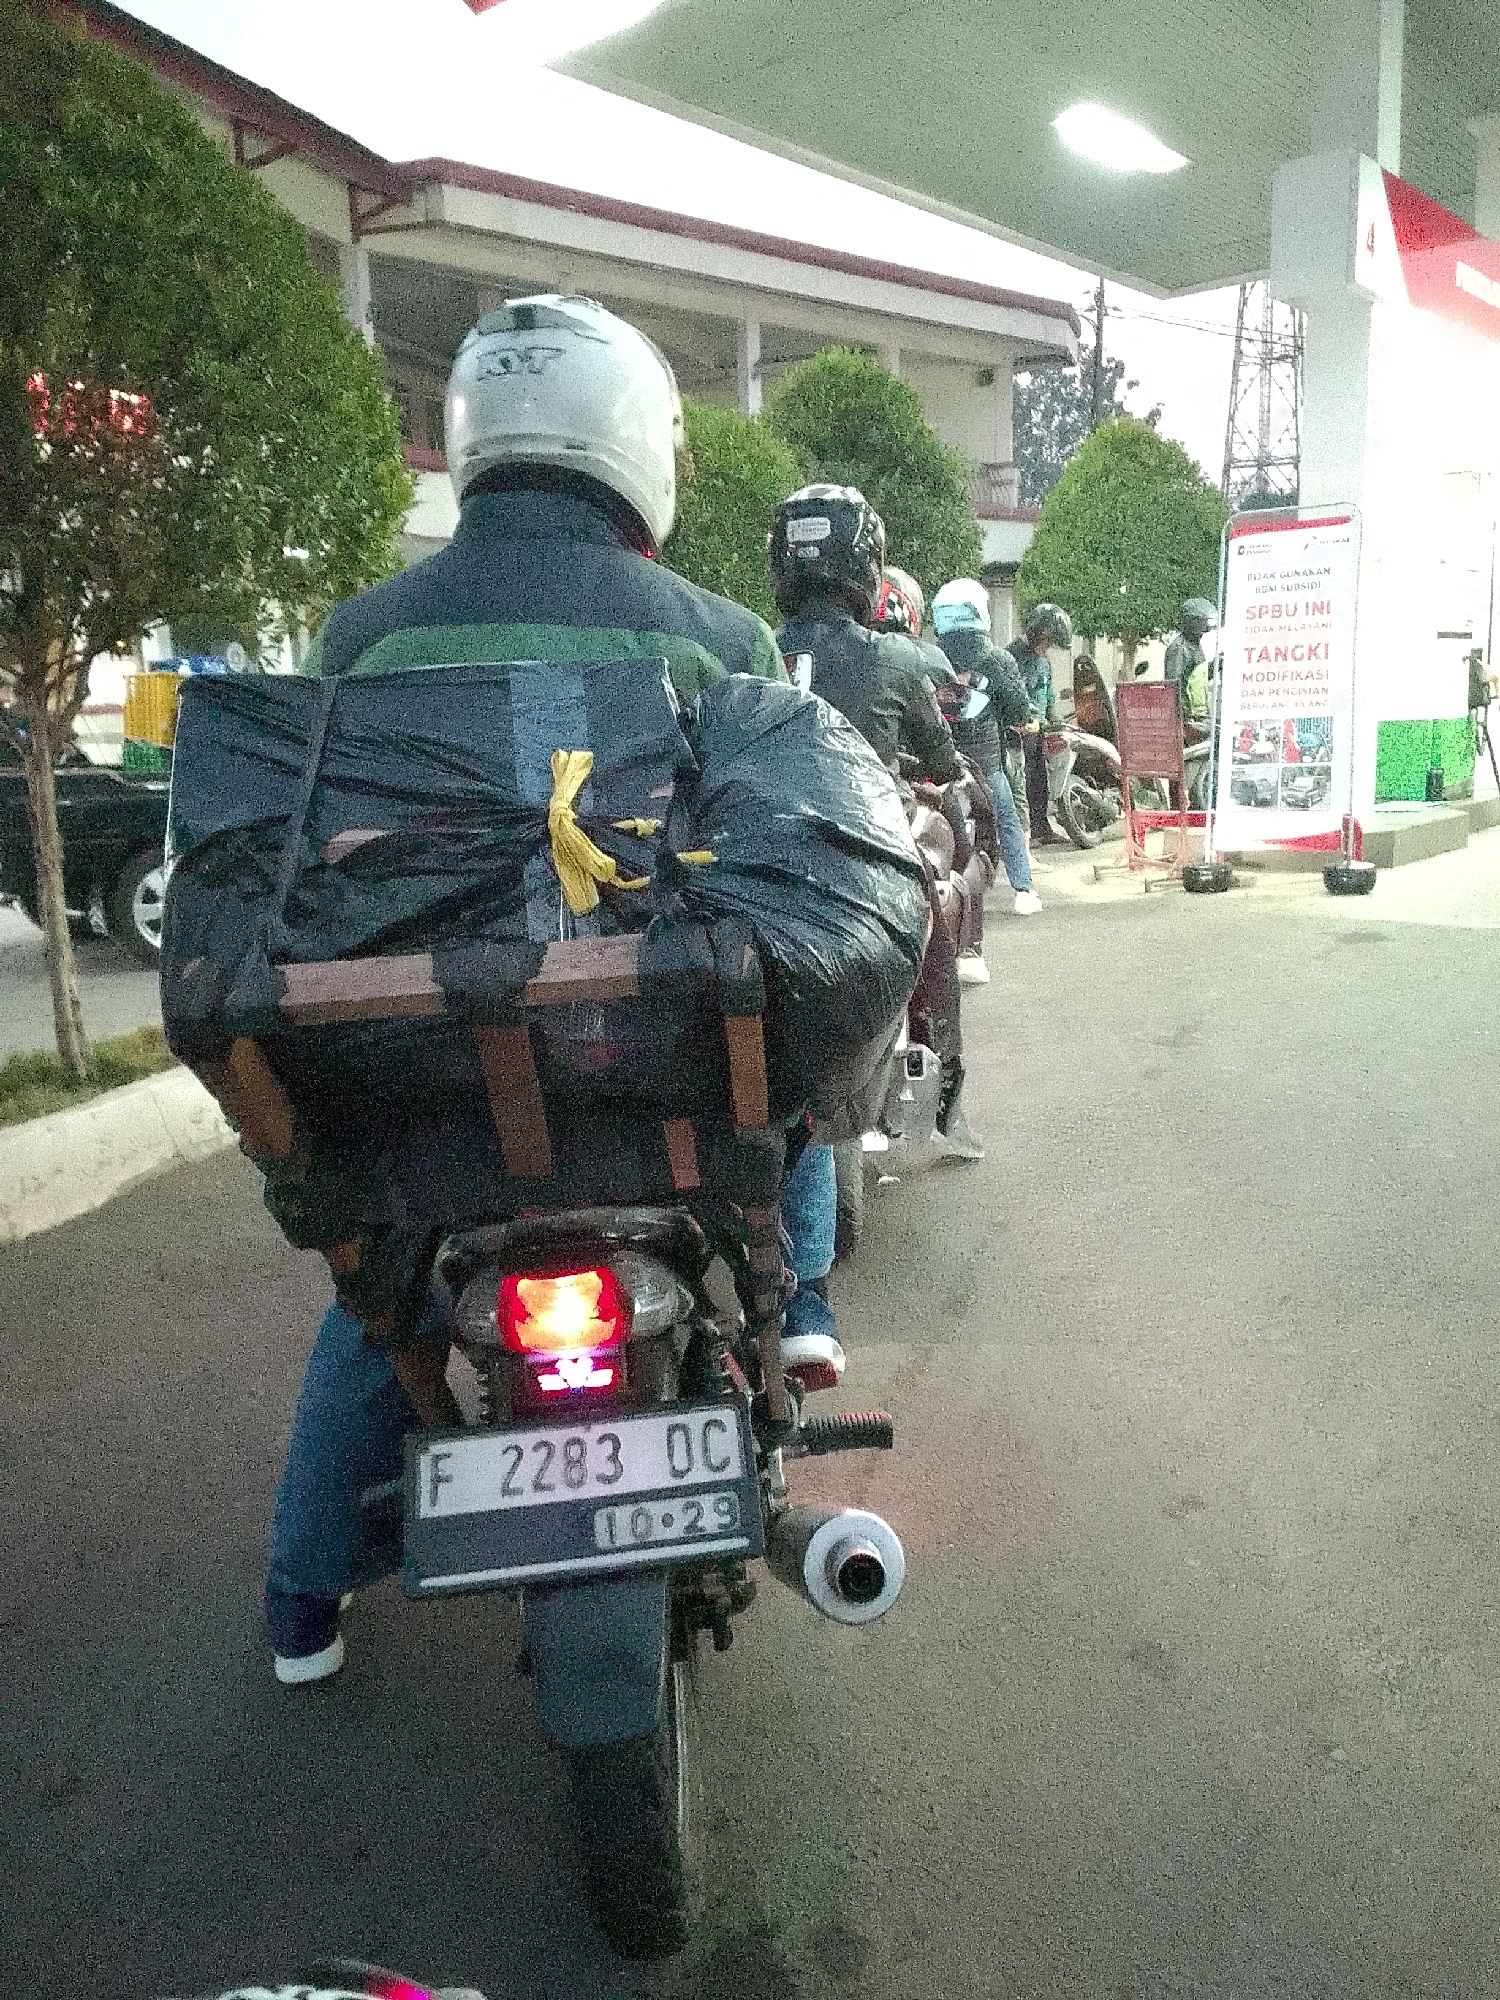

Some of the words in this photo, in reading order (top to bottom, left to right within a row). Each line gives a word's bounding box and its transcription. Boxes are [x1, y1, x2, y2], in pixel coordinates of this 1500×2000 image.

[1279, 566, 1331, 579] GUNAKAN
[1280, 580, 1321, 592] SUBSIDI
[1245, 602, 1298, 621] SPBU
[1305, 599, 1331, 616] INI
[1243, 642, 1330, 664] TANGKI
[1242, 669, 1329, 684] MODIFIKASI
[1241, 688, 1265, 698] DAN
[1268, 686, 1329, 697] PENGISIAN
[429, 1452, 451, 1507] F
[501, 1432, 625, 1498] 2283
